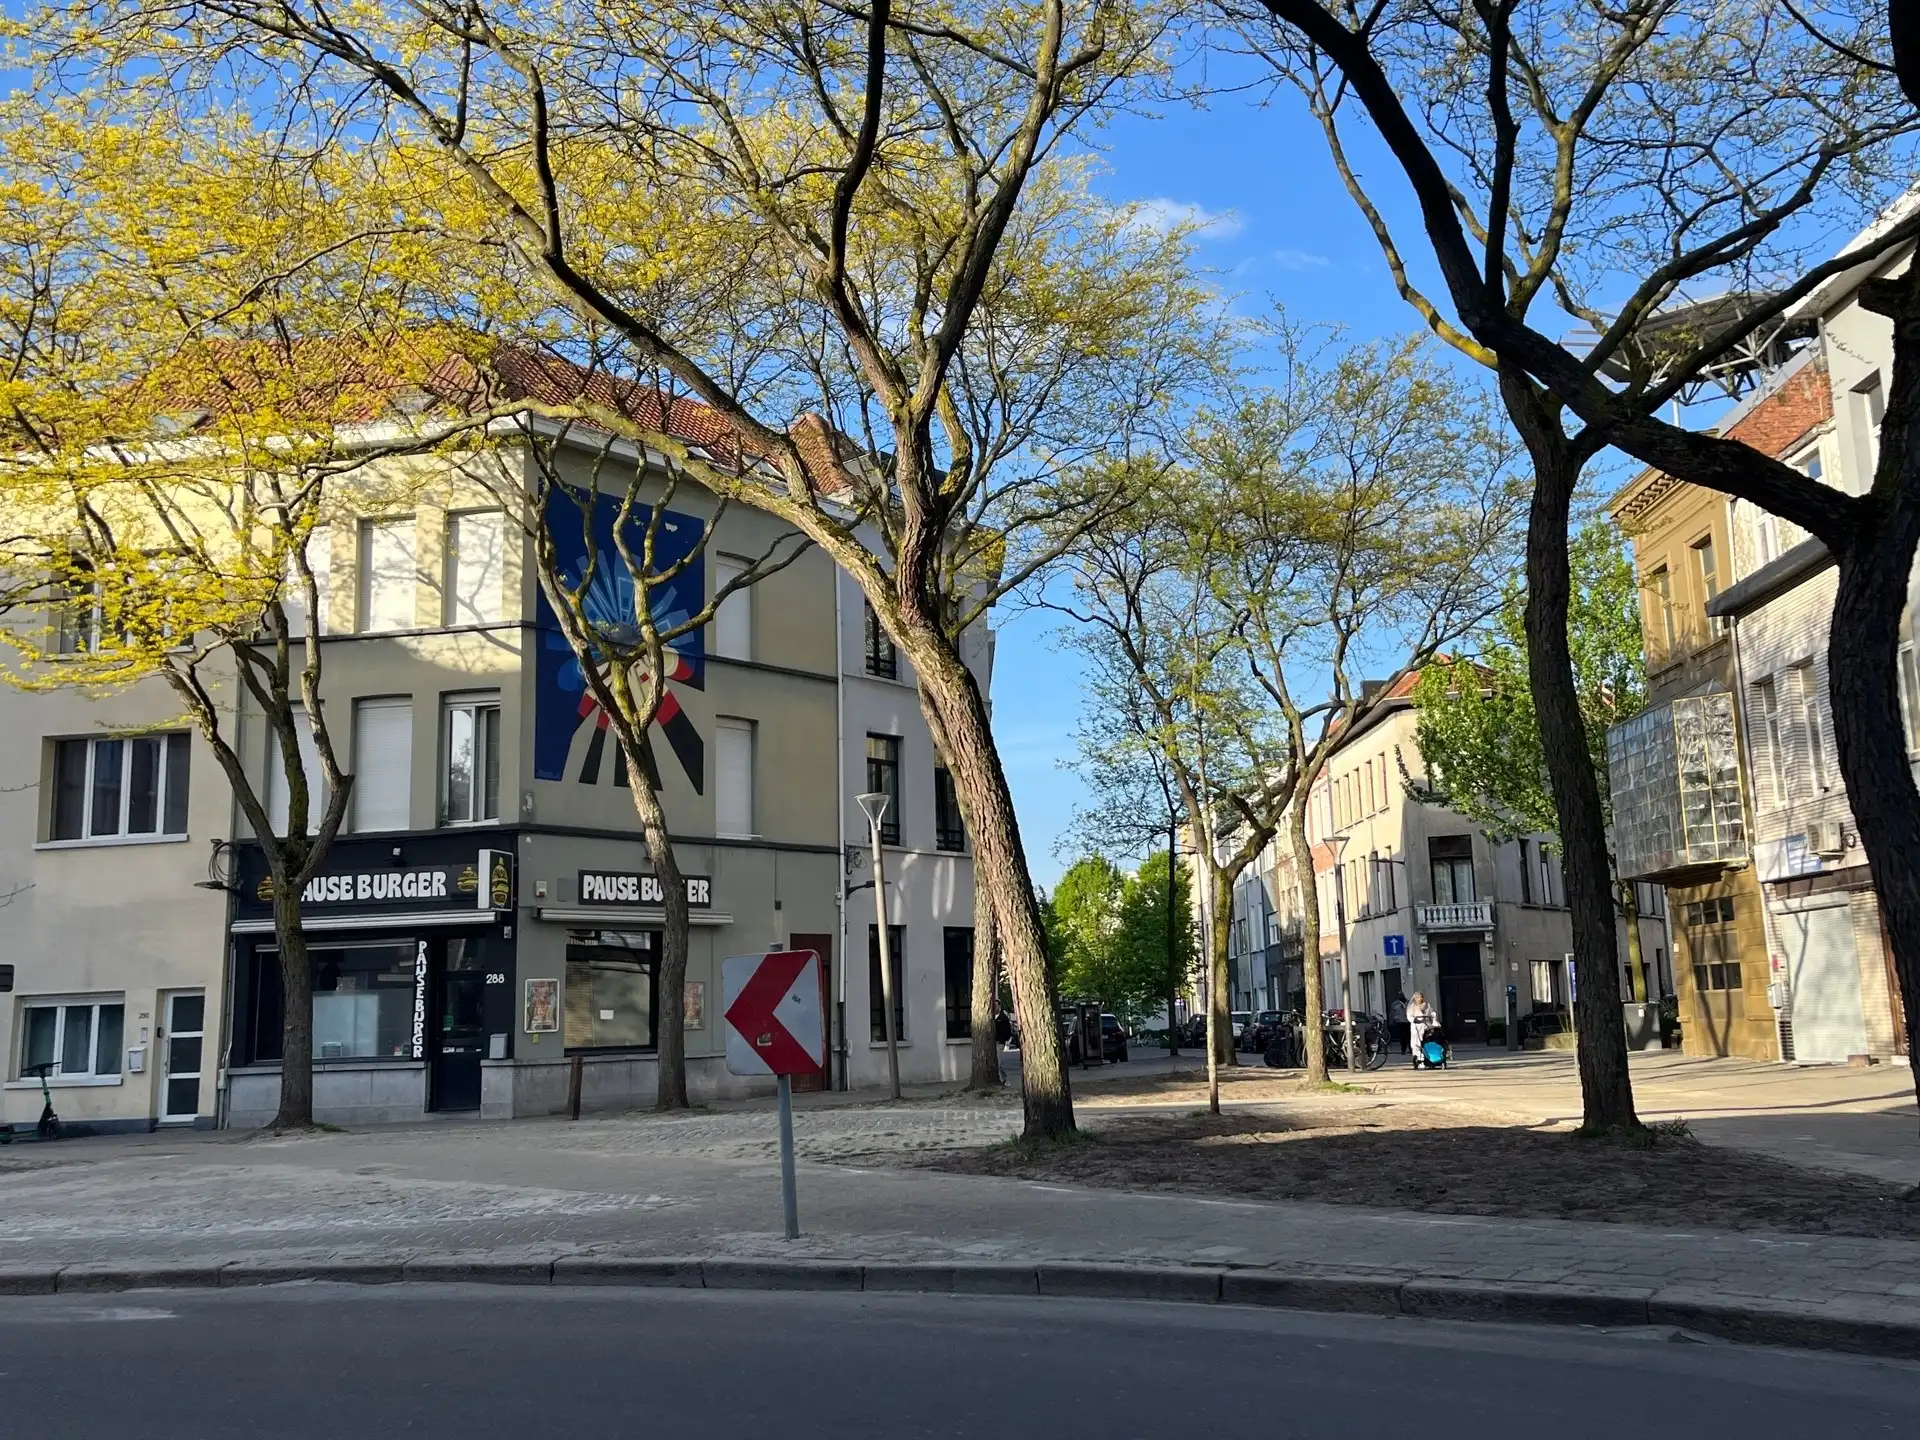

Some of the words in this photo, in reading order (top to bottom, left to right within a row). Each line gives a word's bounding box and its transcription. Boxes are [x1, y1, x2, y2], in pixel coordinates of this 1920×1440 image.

[301, 875, 354, 901] AUSE
[357, 871, 447, 899] BURGER
[583, 874, 639, 901] PAUSE
[641, 877, 709, 903] BUER
[485, 973, 505, 984] 288
